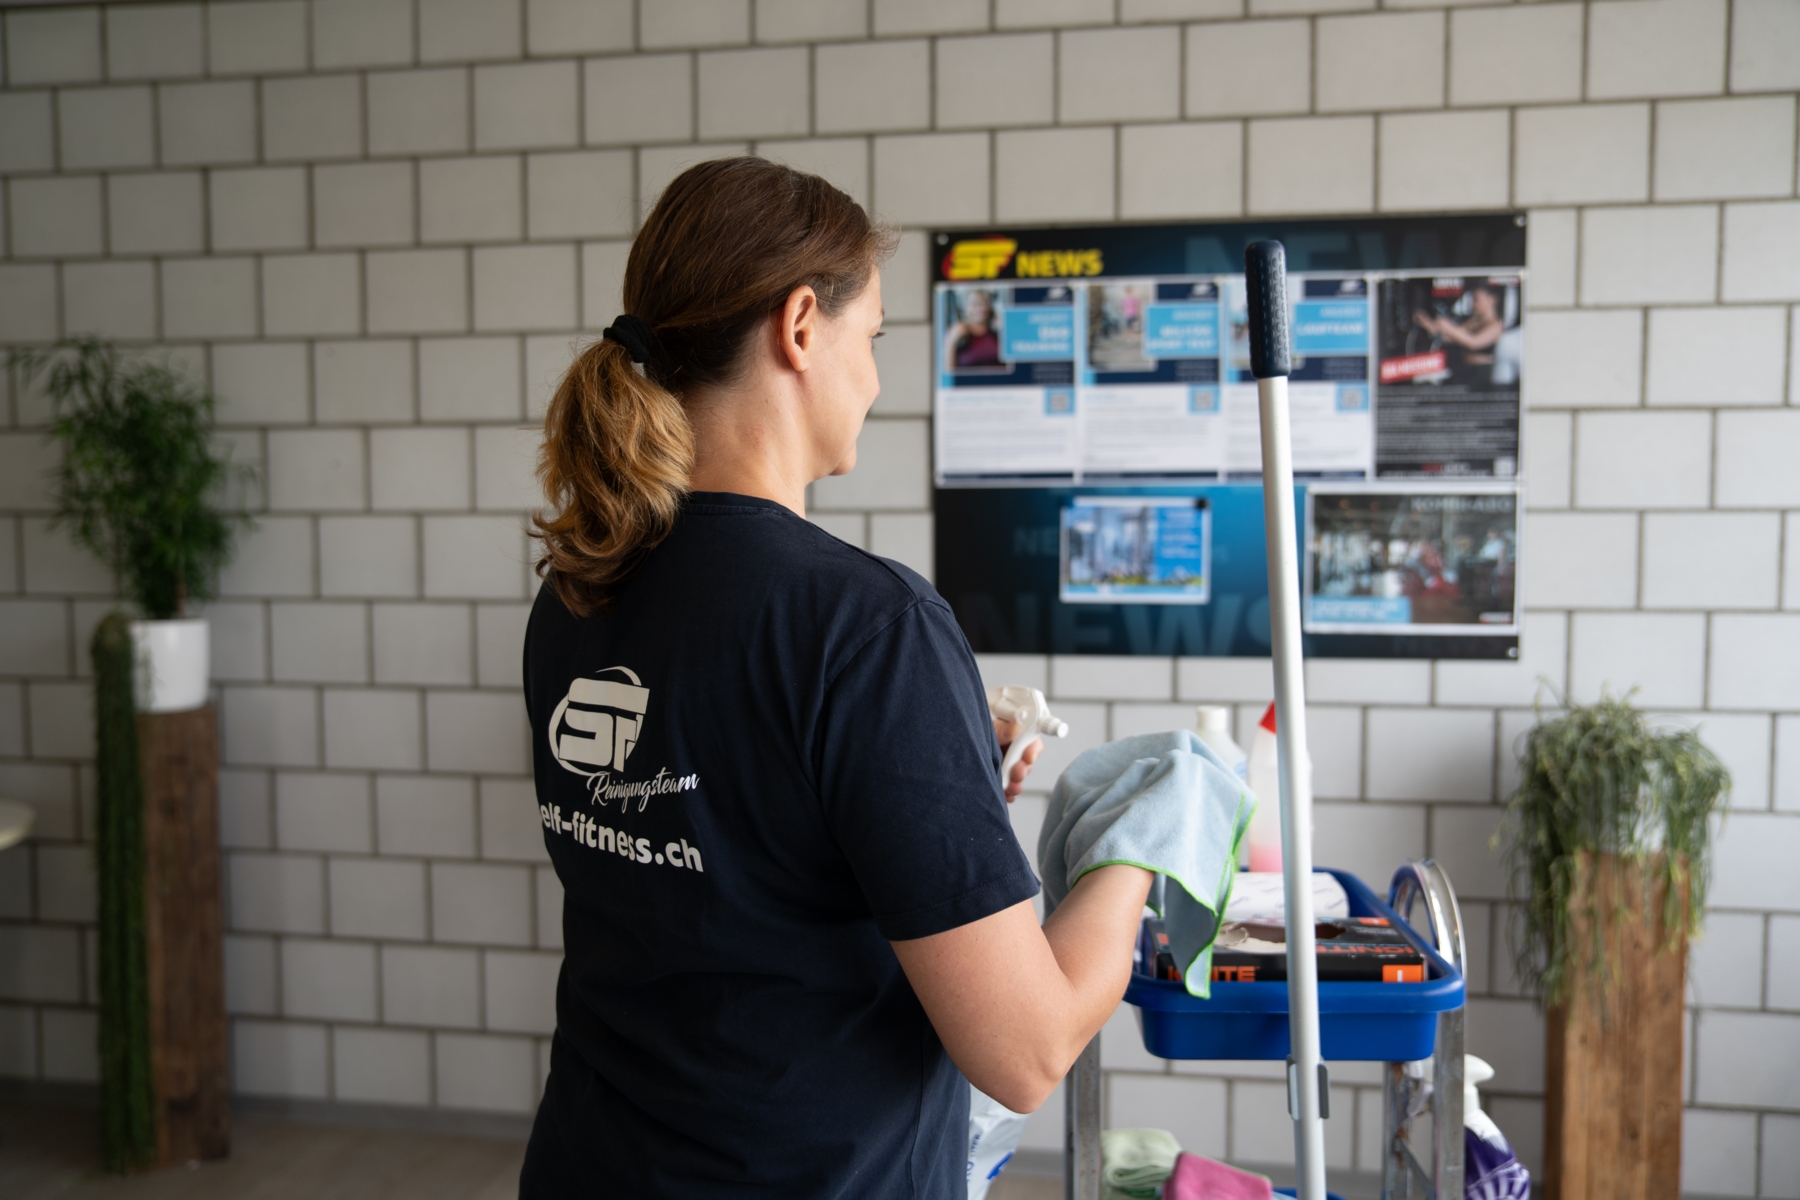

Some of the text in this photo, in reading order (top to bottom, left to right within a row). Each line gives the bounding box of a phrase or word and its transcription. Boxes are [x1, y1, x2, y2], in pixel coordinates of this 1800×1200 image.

[1015, 250, 1104, 277] NEWS
[586, 766, 701, 814] Reinigungsteam
[1167, 965, 1255, 982] IITE
